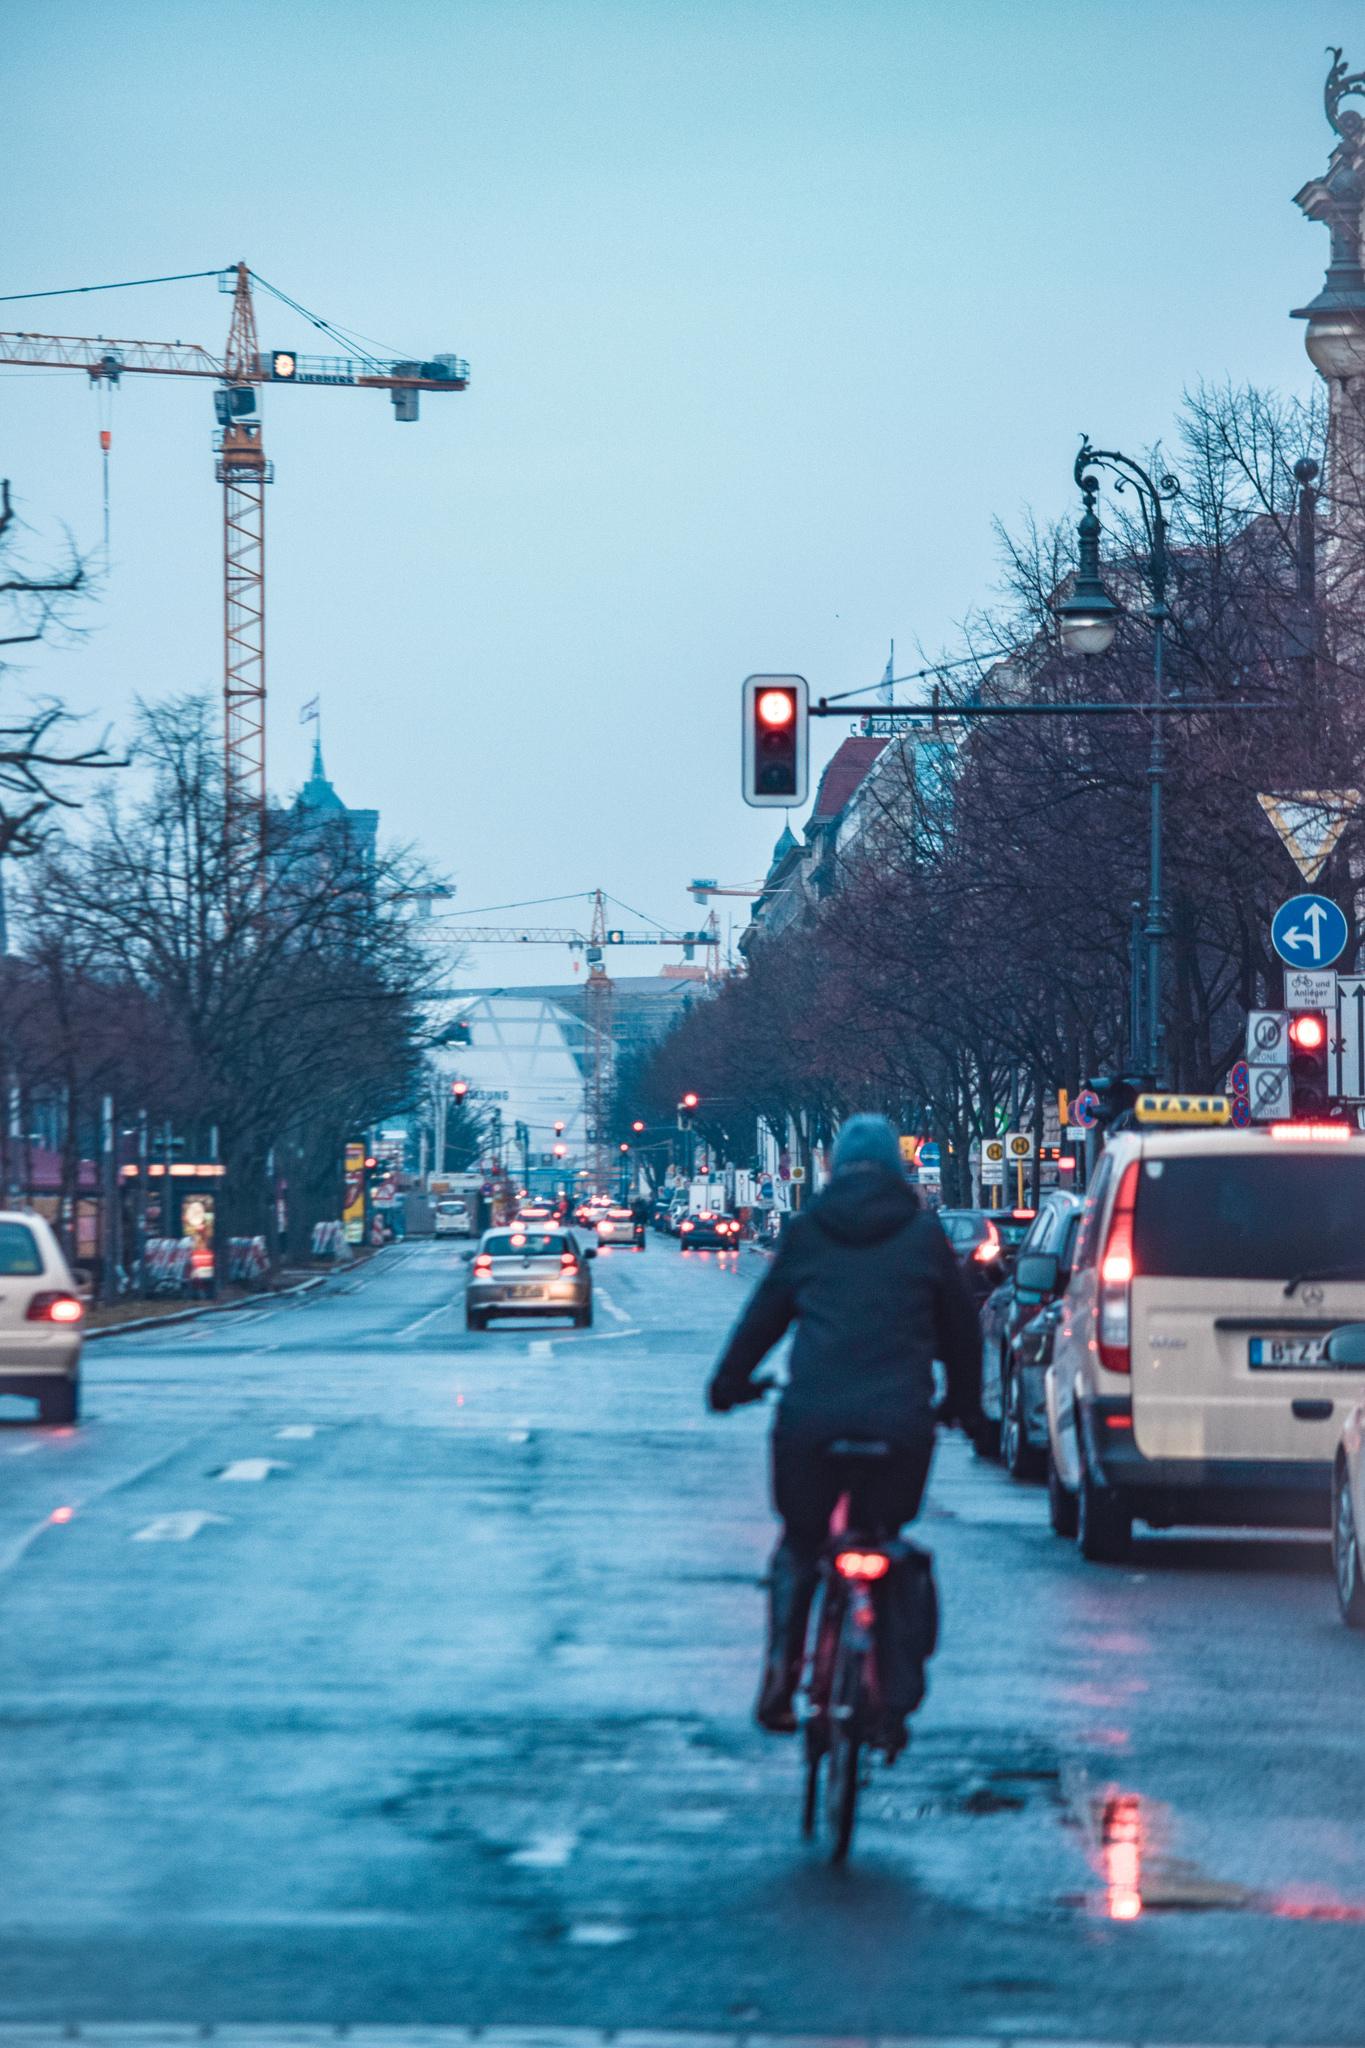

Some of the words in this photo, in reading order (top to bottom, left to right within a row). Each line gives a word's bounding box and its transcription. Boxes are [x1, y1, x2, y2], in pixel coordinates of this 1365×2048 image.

[1315, 980, 1330, 988] und
[1294, 989, 1327, 998] Anlieger
[1304, 998, 1319, 1006] frei
[1262, 1025, 1276, 1042] 10
[1151, 1098, 1214, 1112] TAXI
